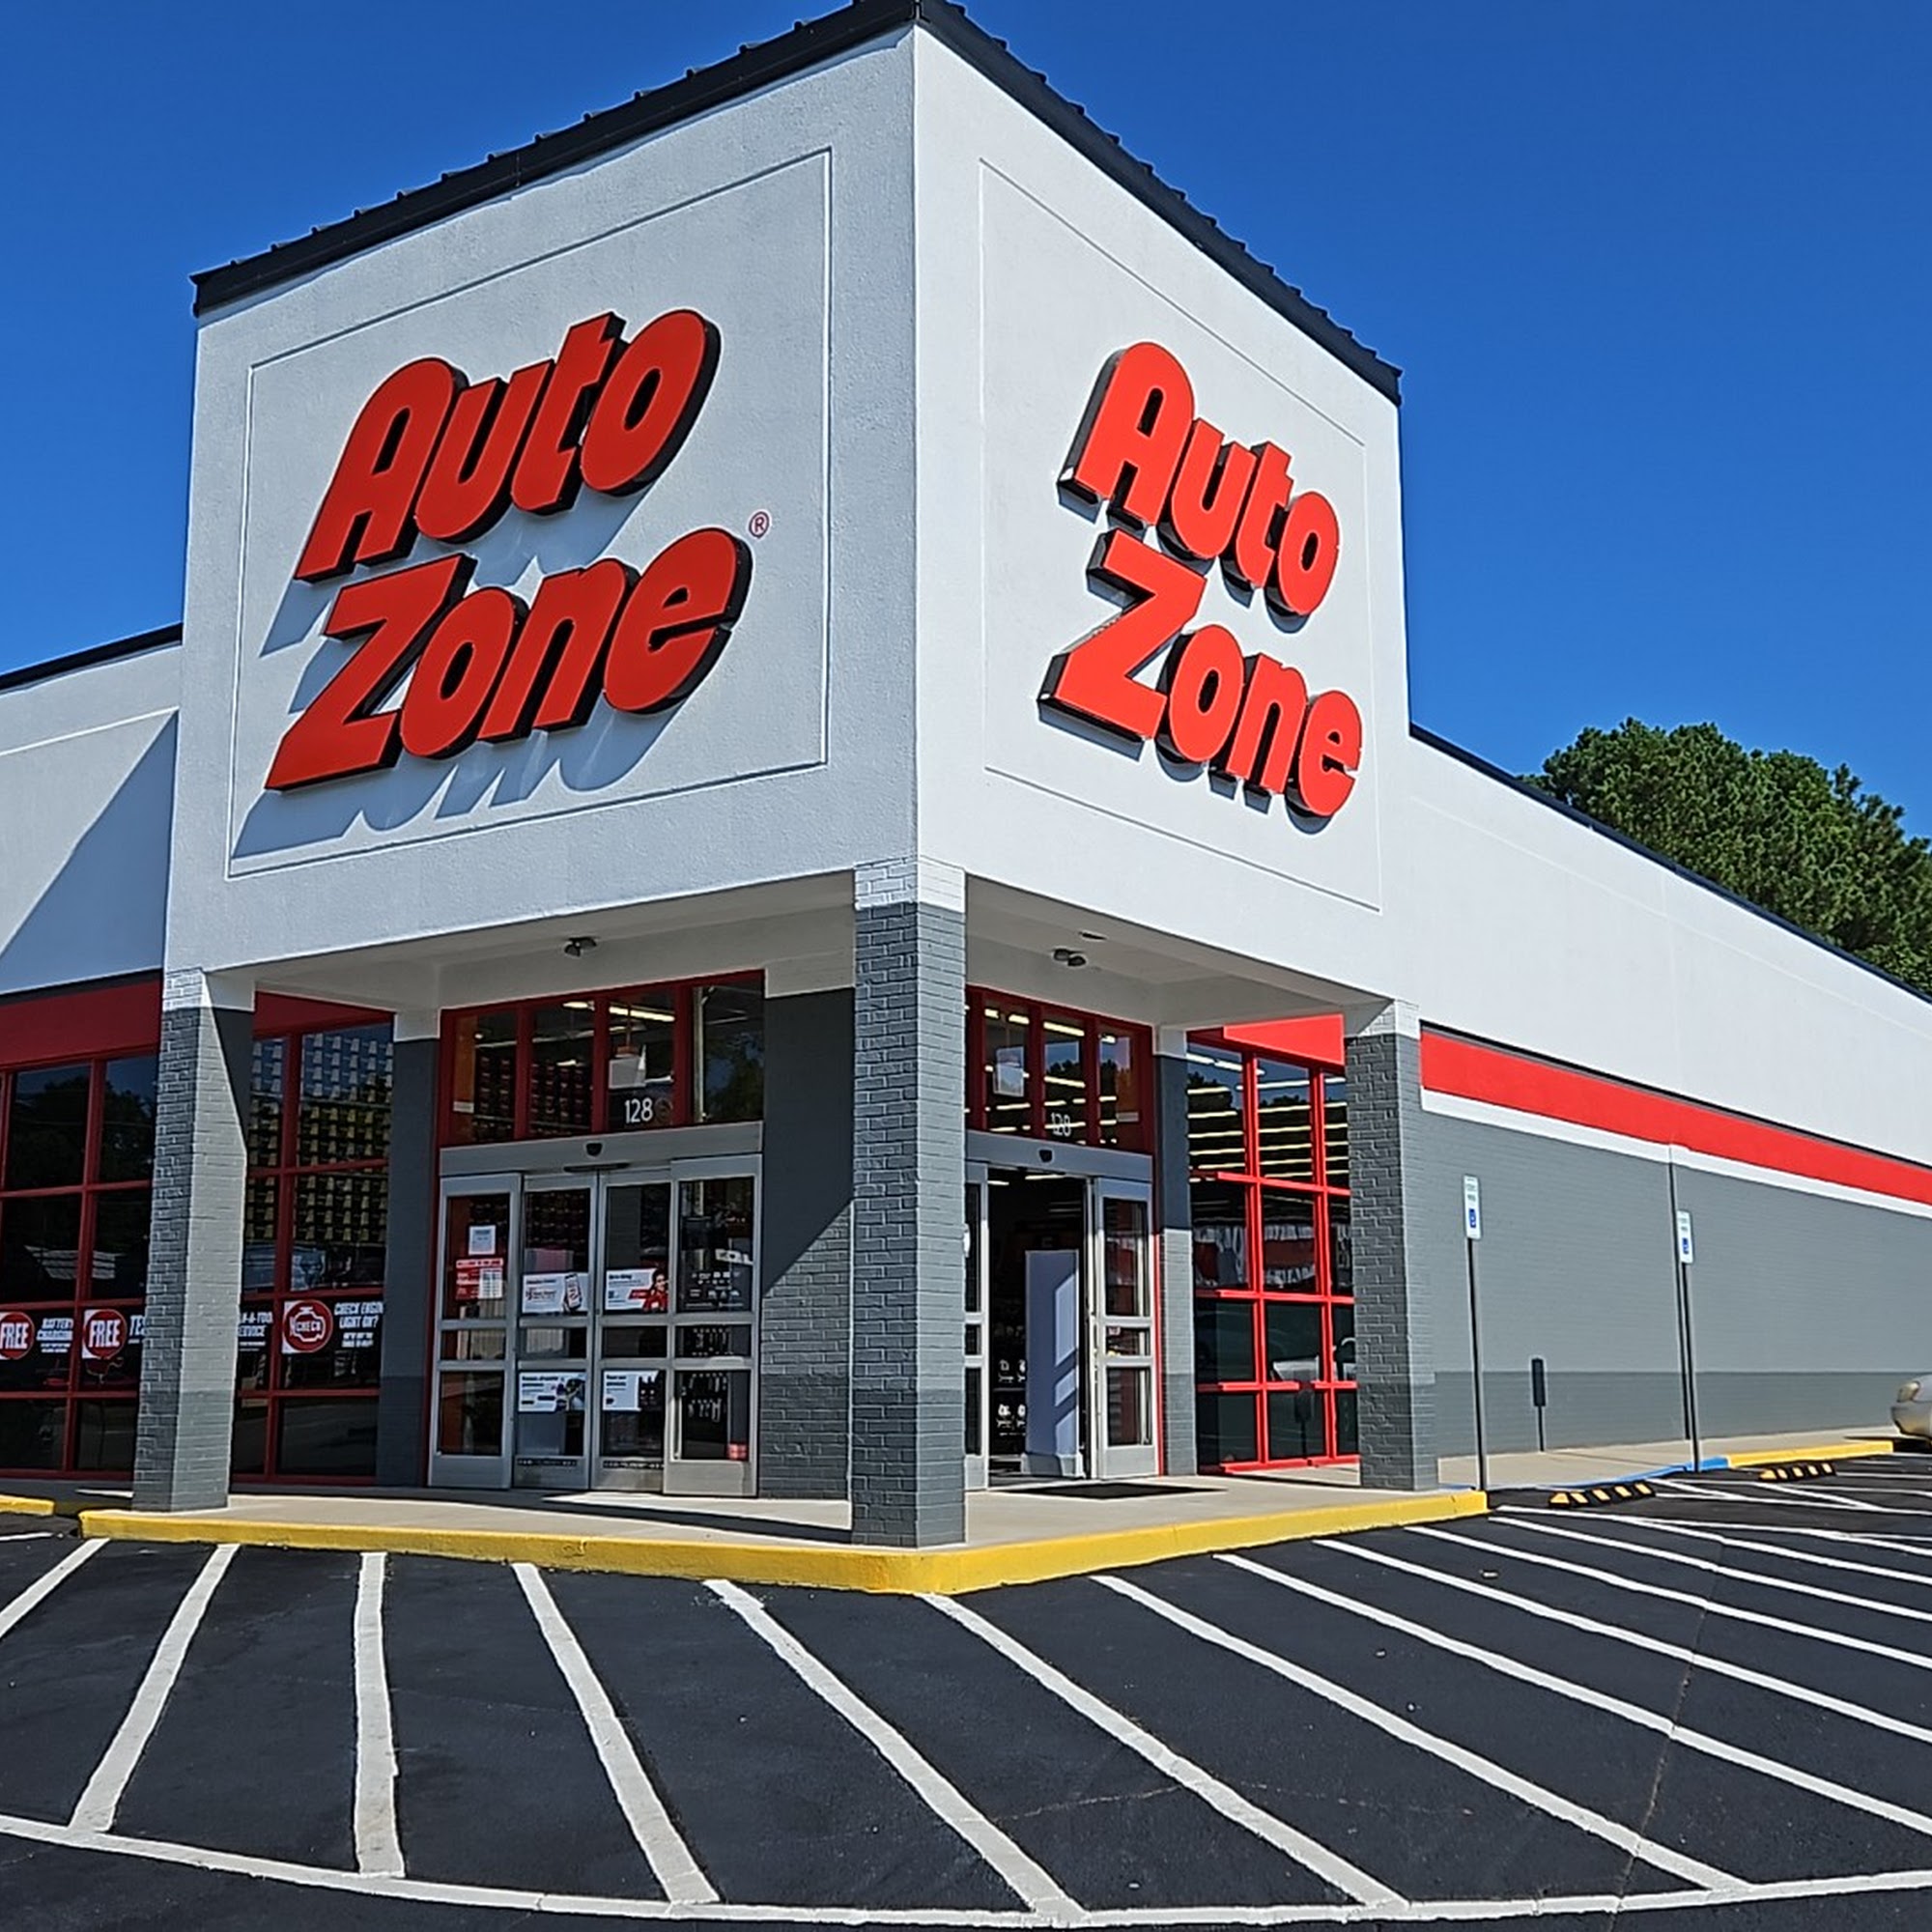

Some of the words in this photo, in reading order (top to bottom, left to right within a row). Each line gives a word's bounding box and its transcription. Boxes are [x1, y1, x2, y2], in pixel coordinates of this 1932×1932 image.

[293, 308, 722, 583] Auto
[1059, 341, 1340, 618] Auto
[264, 526, 753, 792] Zone
[1039, 527, 1363, 819] Zone
[624, 1097, 653, 1123] 128
[0, 1321, 30, 1350] FREE
[88, 1320, 121, 1348] FREE
[296, 1321, 321, 1332] CHECK
